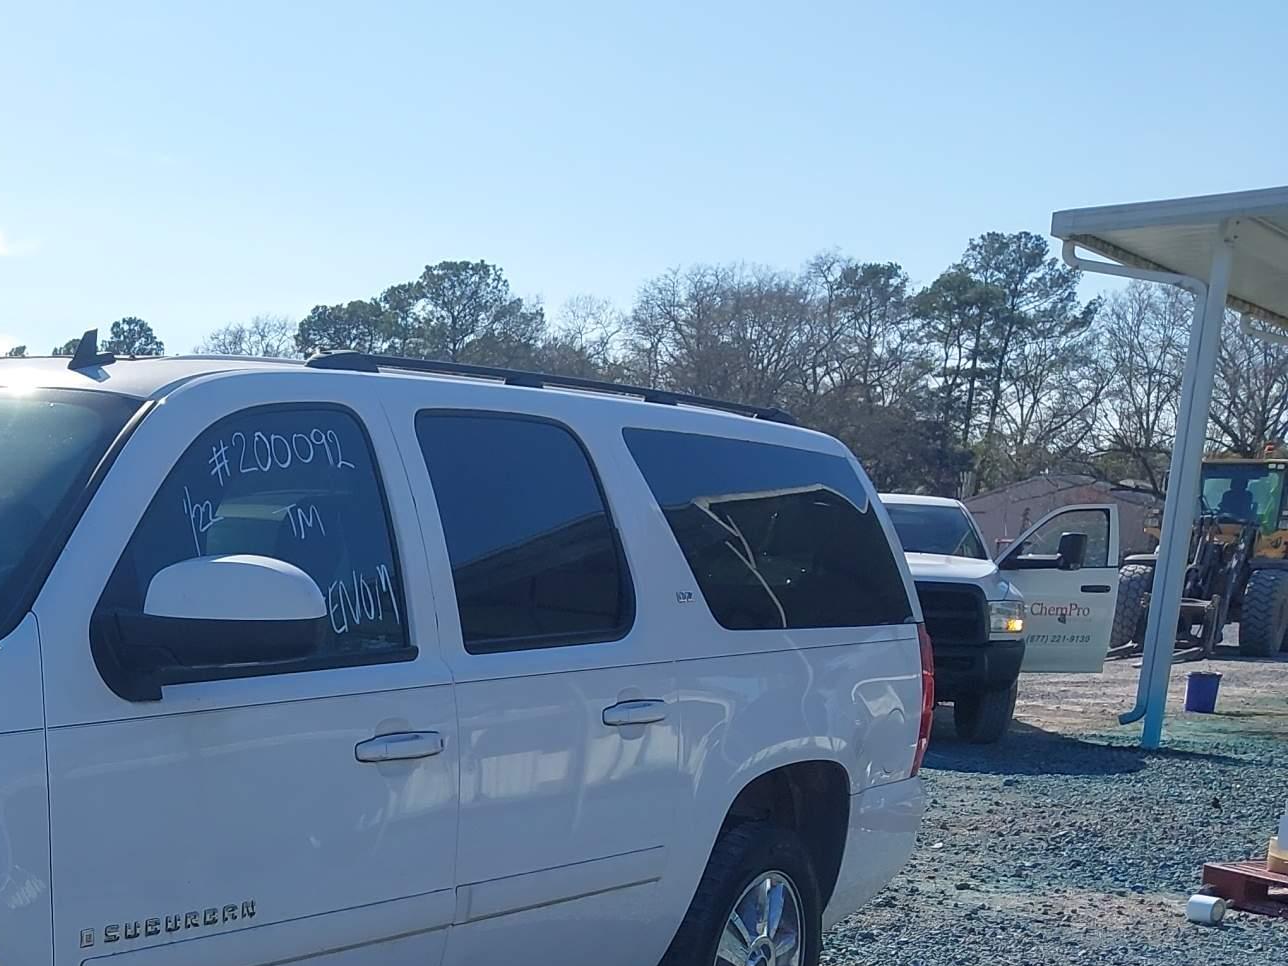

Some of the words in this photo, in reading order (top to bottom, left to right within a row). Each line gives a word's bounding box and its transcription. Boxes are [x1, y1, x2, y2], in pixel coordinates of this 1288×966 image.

[208, 428, 355, 486] #200092
[272, 503, 326, 539] TM
[1030, 602, 1090, 617] ChemPro
[103, 900, 256, 943] SUBURBAN
